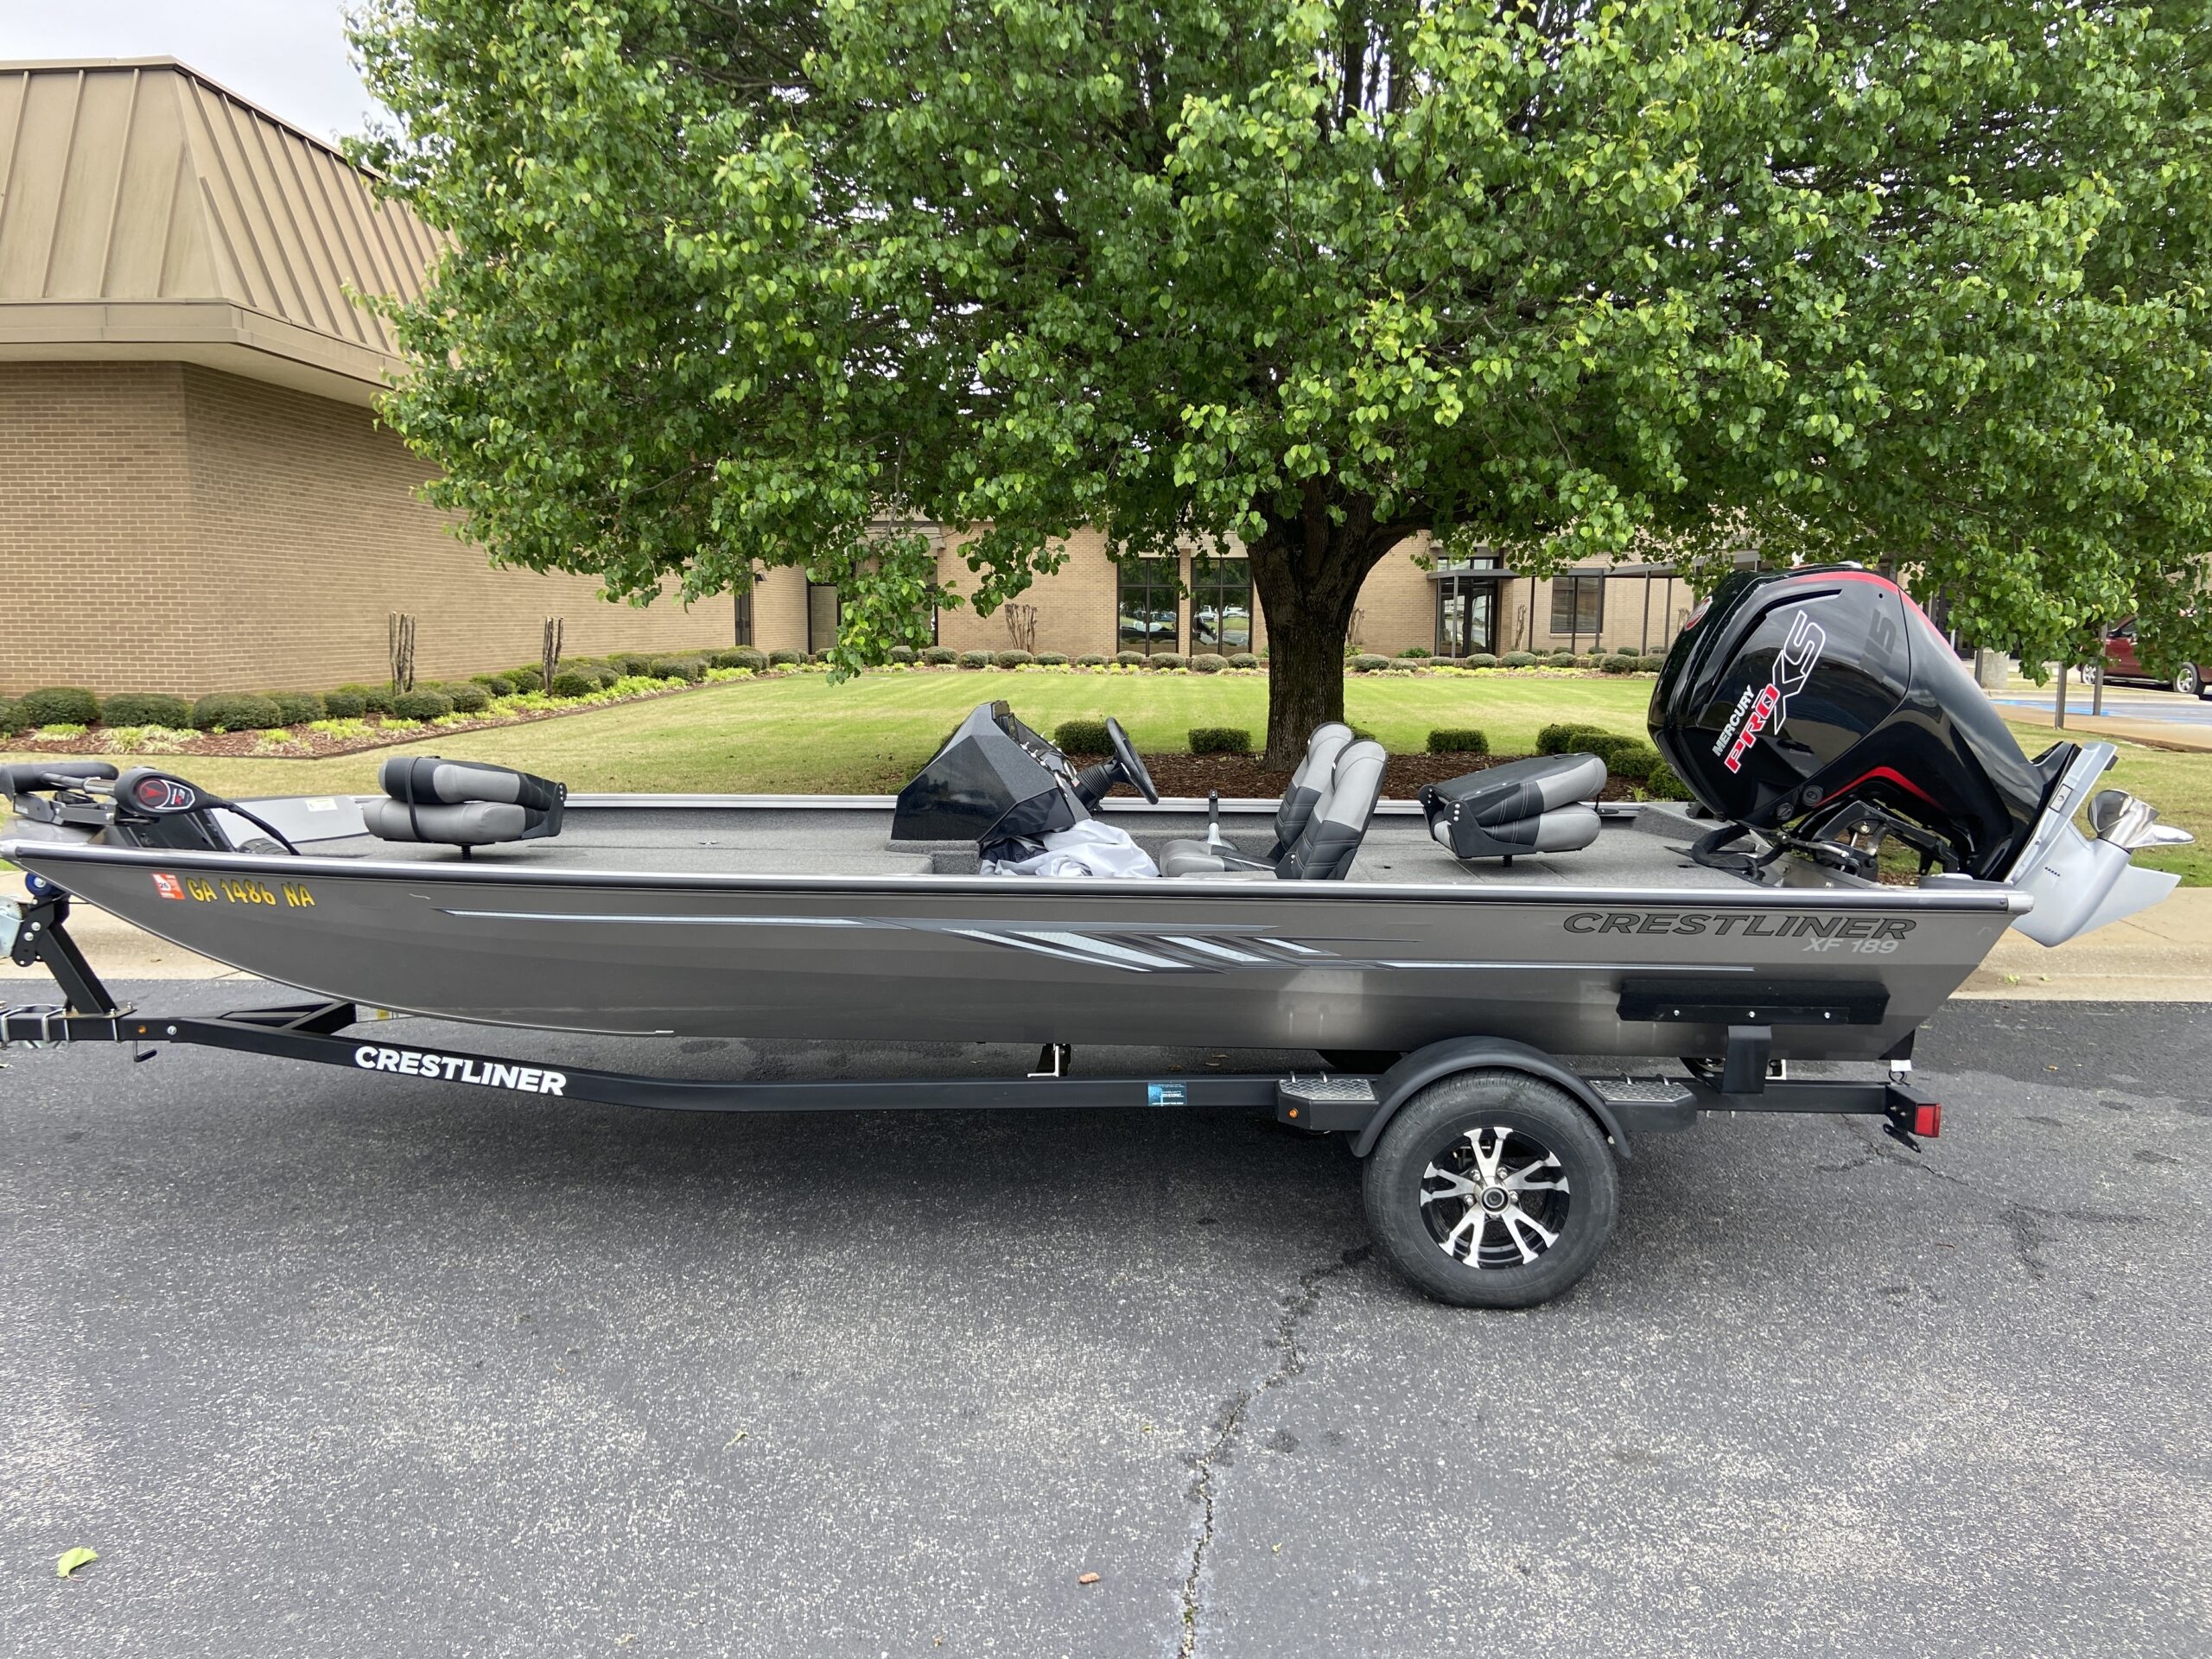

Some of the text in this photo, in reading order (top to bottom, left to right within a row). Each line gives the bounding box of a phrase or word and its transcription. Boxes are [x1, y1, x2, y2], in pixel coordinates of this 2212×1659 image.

[1724, 610, 1826, 773] PRO XS
[1712, 684, 1755, 757] MERCURY
[186, 877, 315, 908] GA 1486 NA
[1563, 912, 1916, 939] CRESTLINER
[1802, 938, 1899, 954] XF 189
[355, 1046, 567, 1096] CRESTLINER
